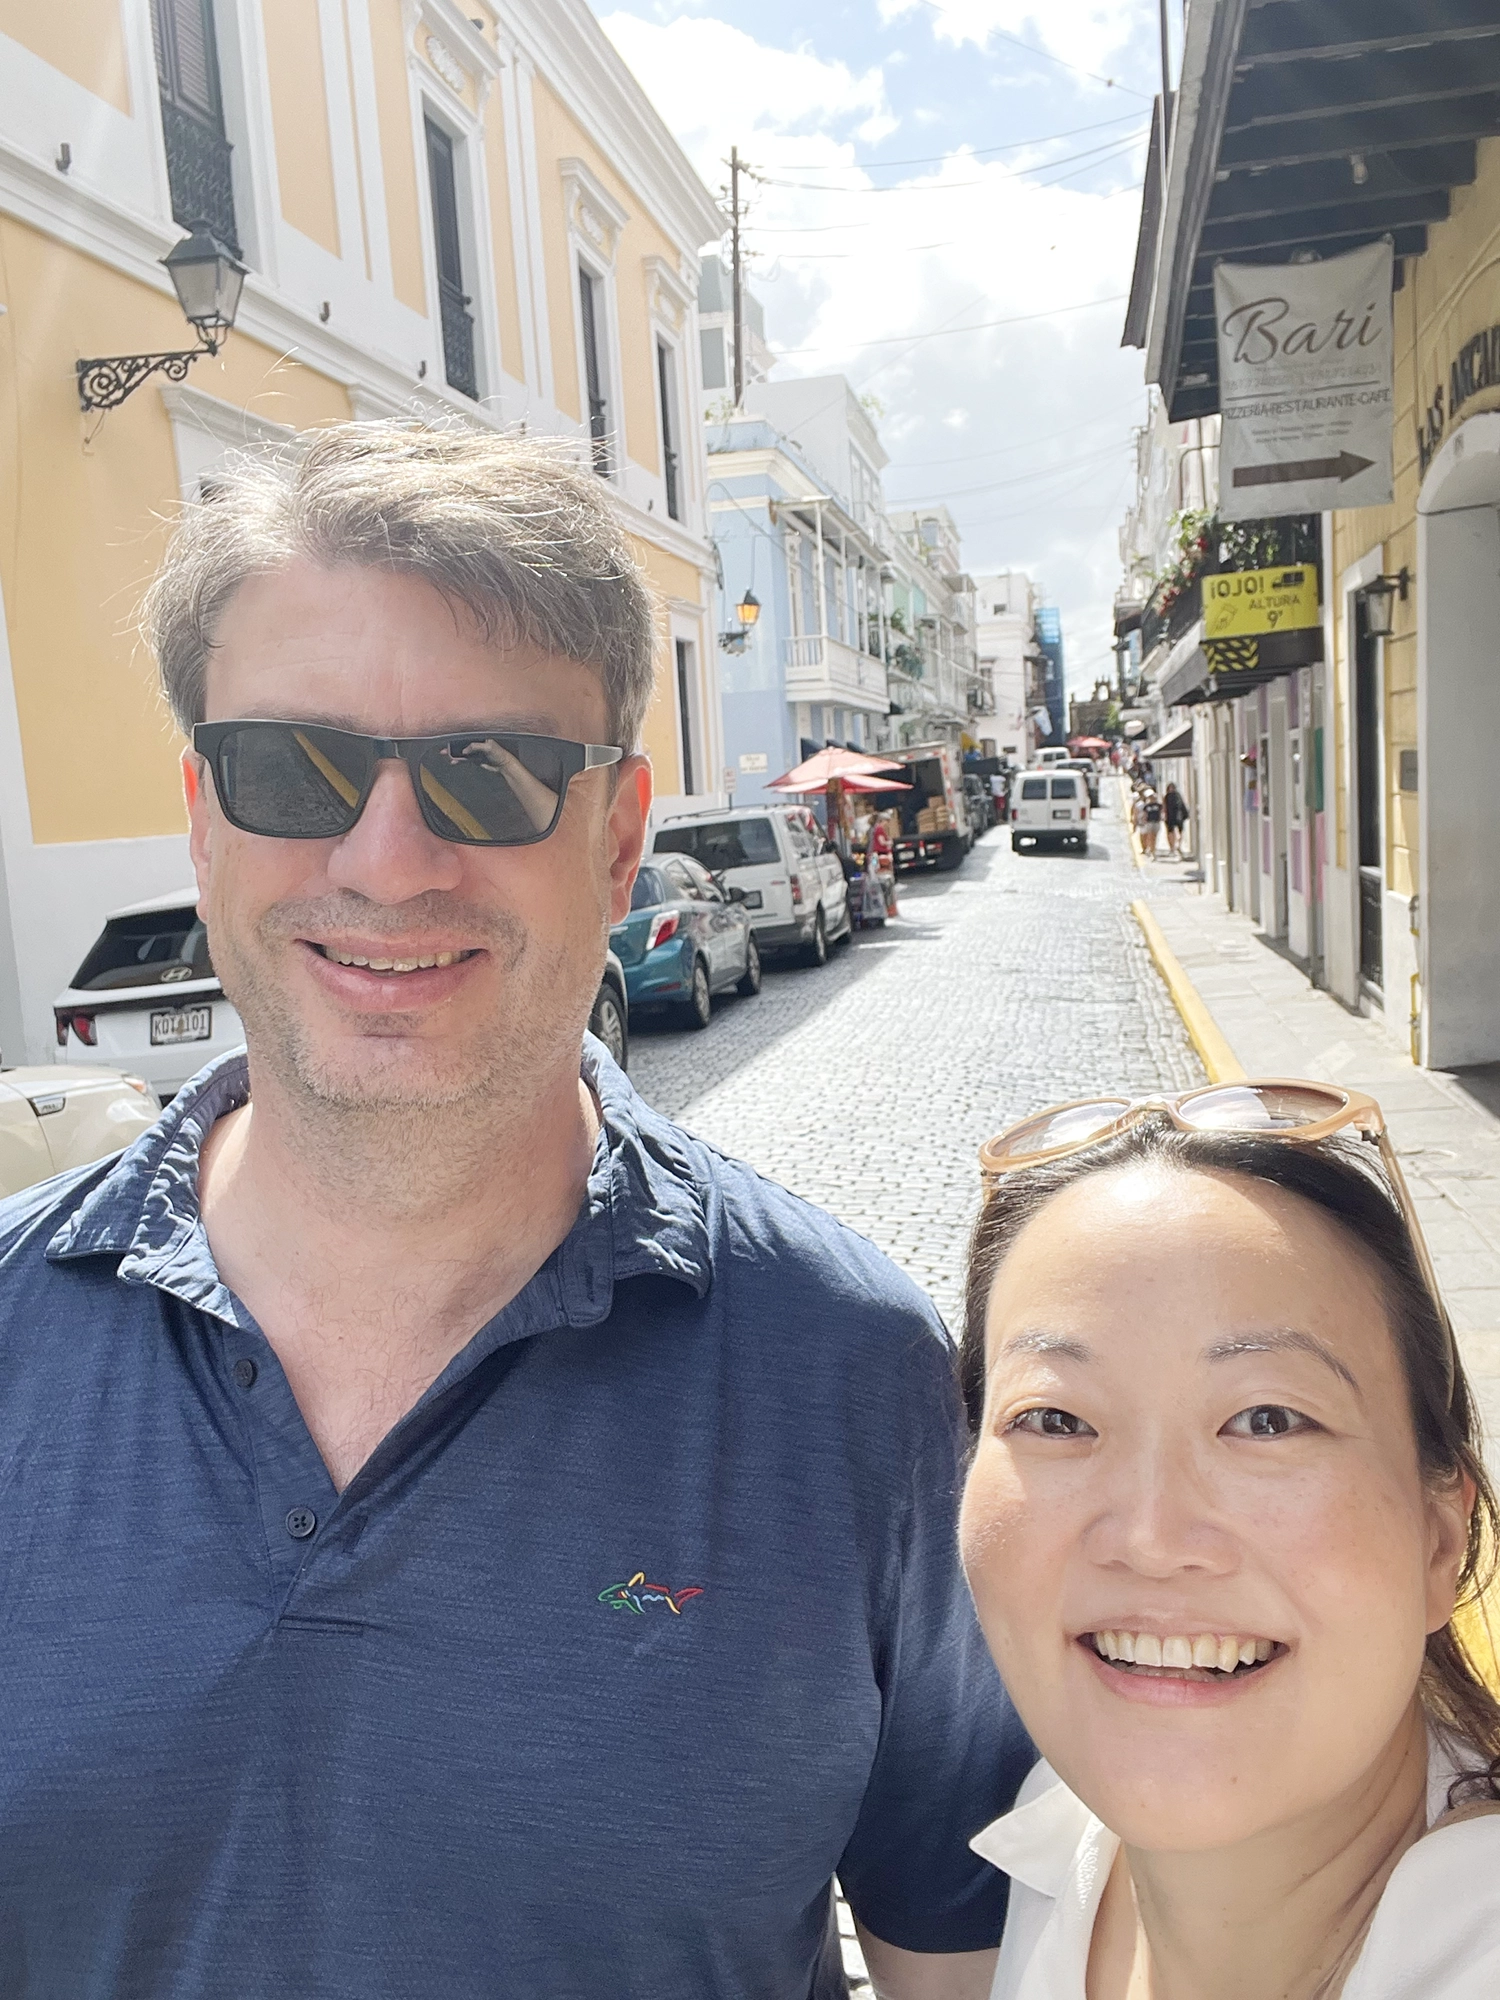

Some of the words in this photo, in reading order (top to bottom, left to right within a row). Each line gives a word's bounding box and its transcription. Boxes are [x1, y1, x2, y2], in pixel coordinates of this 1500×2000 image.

[1223, 297, 1383, 365] Bari
[1417, 384, 1444, 482] LAS
[1249, 594, 1300, 611] ALTURA
